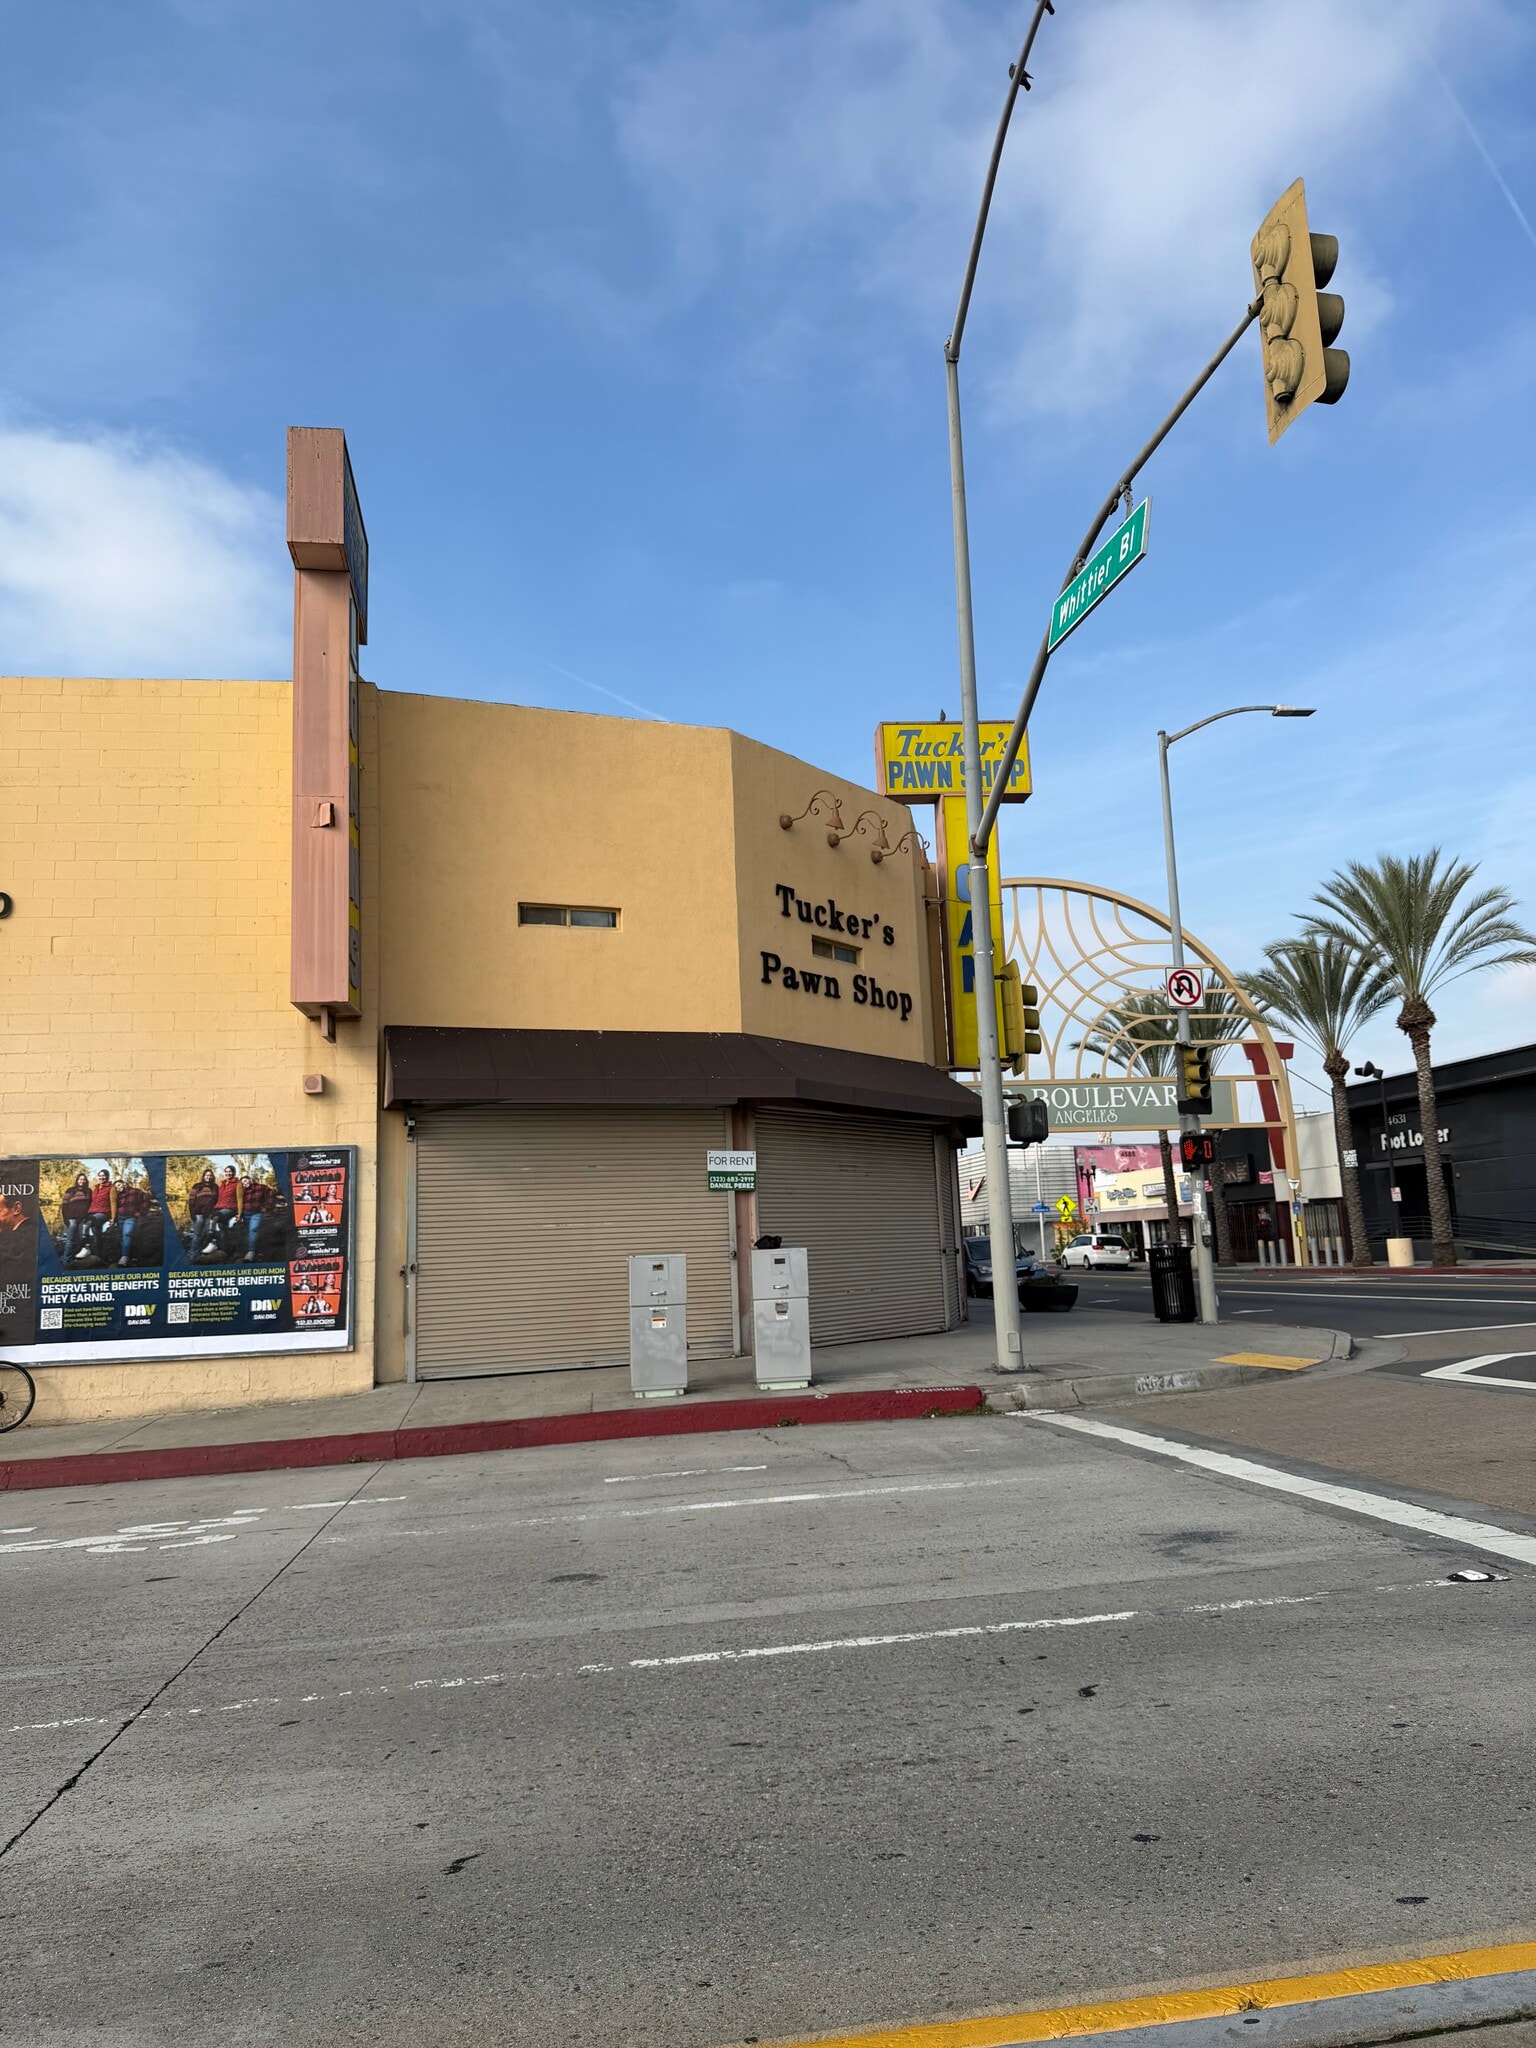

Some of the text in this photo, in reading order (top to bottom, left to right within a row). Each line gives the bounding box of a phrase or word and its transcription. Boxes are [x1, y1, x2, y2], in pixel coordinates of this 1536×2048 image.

[1059, 525, 1136, 628] Whittier Bl
[897, 729, 1009, 757] Tuckr'
[888, 760, 953, 788] PAWN
[775, 883, 896, 946] Tucker's
[760, 951, 913, 1021] Pawn Shop
[1031, 1084, 1178, 1109] BOULEVAR
[1054, 1108, 1119, 1124] ANGELES
[1408, 1128, 1450, 1147] Loer
[709, 1156, 754, 1166] FOR RENT
[41, 1276, 72, 1284] BECAUSE
[73, 1274, 110, 1282] VETERANS
[111, 1273, 126, 1281] LIKE
[126, 1272, 142, 1280] OUR
[199, 1269, 237, 1277] VETERANS
[237, 1268, 252, 1276] LIKE
[41, 1280, 160, 1294] DESERVE THE BENEFITS
[168, 1275, 286, 1289] DESERVE THE BENEFITS
[41, 1292, 115, 1305] THEY EARNED.
[168, 1287, 242, 1299] THEY EARNED.
[125, 1303, 157, 1317] DAV
[250, 1298, 282, 1312] DAV
